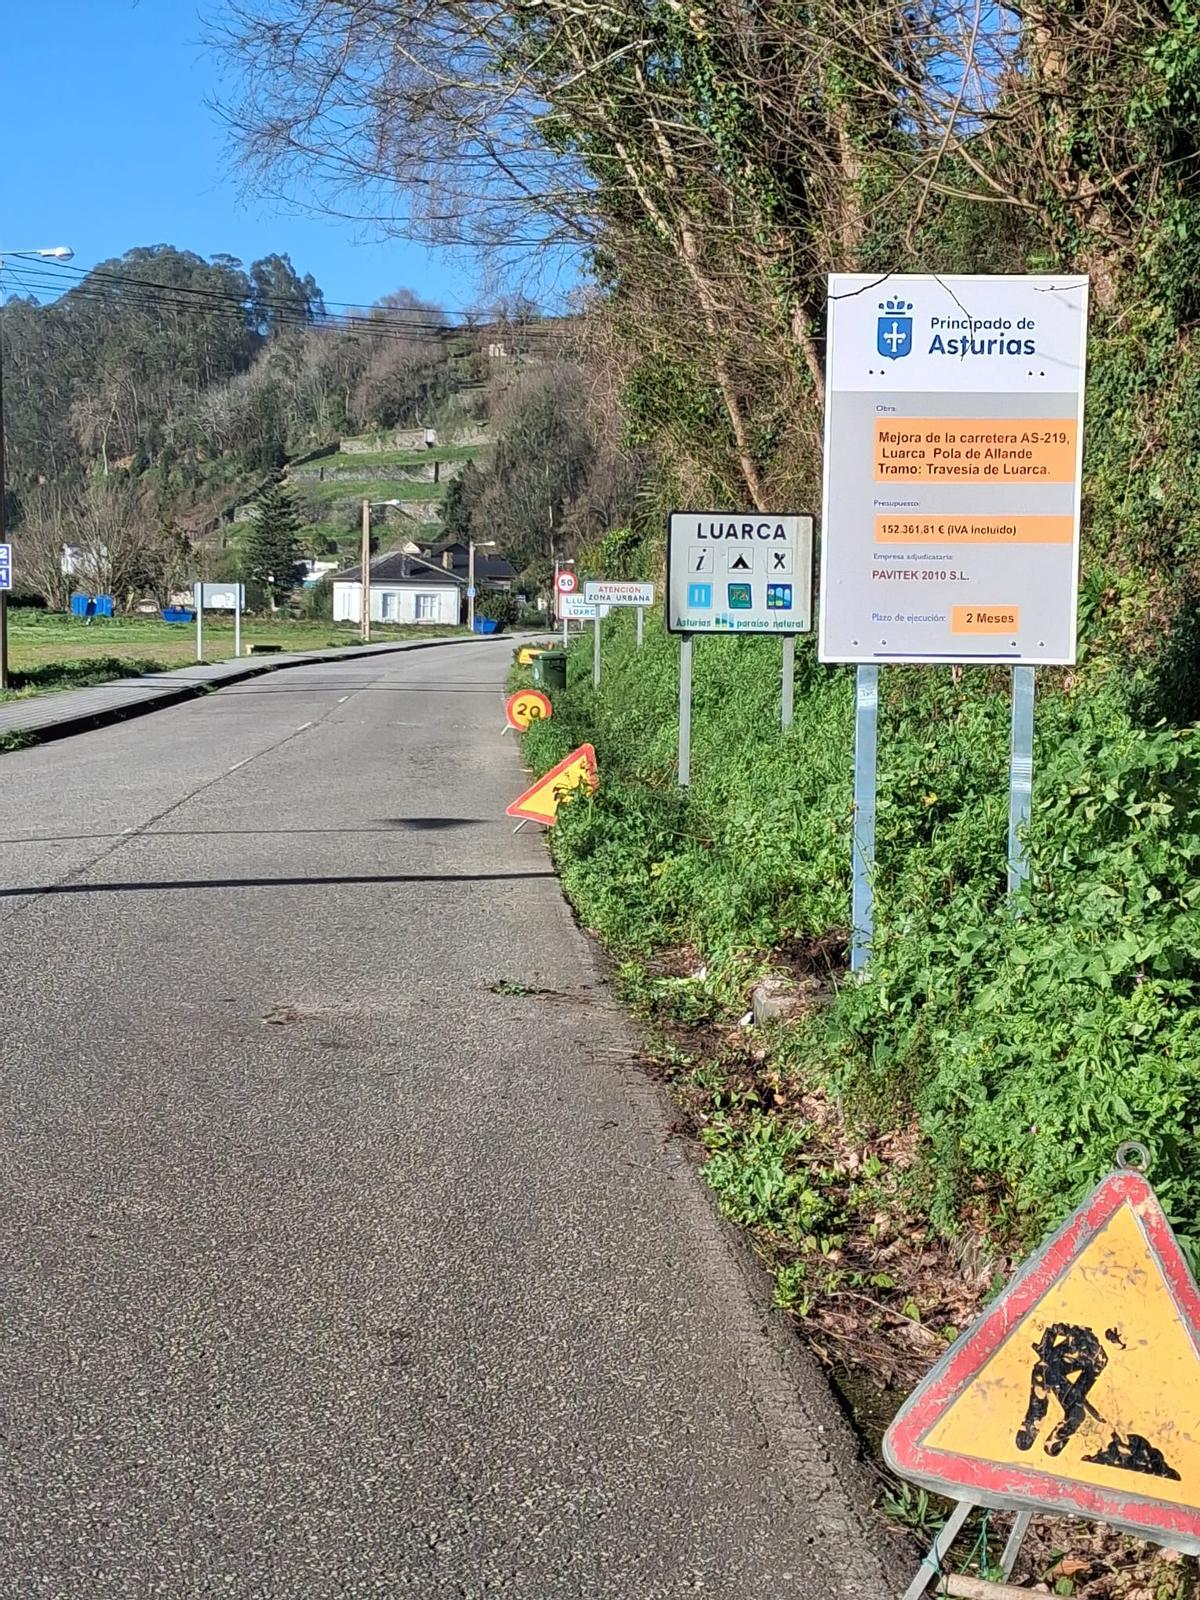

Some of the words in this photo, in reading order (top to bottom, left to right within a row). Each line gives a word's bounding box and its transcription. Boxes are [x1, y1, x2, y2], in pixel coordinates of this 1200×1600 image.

[931, 317, 1012, 332] Principado
[1017, 317, 1035, 330] de
[928, 332, 1036, 355] Asturias
[879, 432, 921, 445] Mejora
[925, 432, 941, 443] de
[945, 432, 956, 443] la
[960, 433, 1017, 443] carretera
[1020, 432, 1070, 445] AS-219,
[882, 448, 925, 458] Luarca
[933, 448, 961, 459] Pola
[965, 448, 981, 459] de
[984, 448, 1032, 459] Allande
[878, 463, 922, 474] Tramo:
[983, 464, 999, 475] de
[1003, 464, 1050, 475] Luarca.
[697, 523, 786, 540] LUARCA
[938, 525, 945, 534] €
[947, 525, 968, 536] (IVA
[873, 553, 904, 561] Empresa
[872, 570, 919, 580] PAVITEK
[921, 571, 946, 580] 2010
[949, 571, 970, 580] S.L.
[598, 585, 641, 593] ATENCIÓN
[676, 616, 711, 627] Asturias
[773, 619, 804, 628] natural
[872, 613, 892, 622] Plazo
[894, 613, 904, 622] de
[907, 613, 946, 624] ejecución:
[966, 613, 973, 623] 2
[976, 613, 1014, 623] Meses
[516, 703, 541, 718] 20
